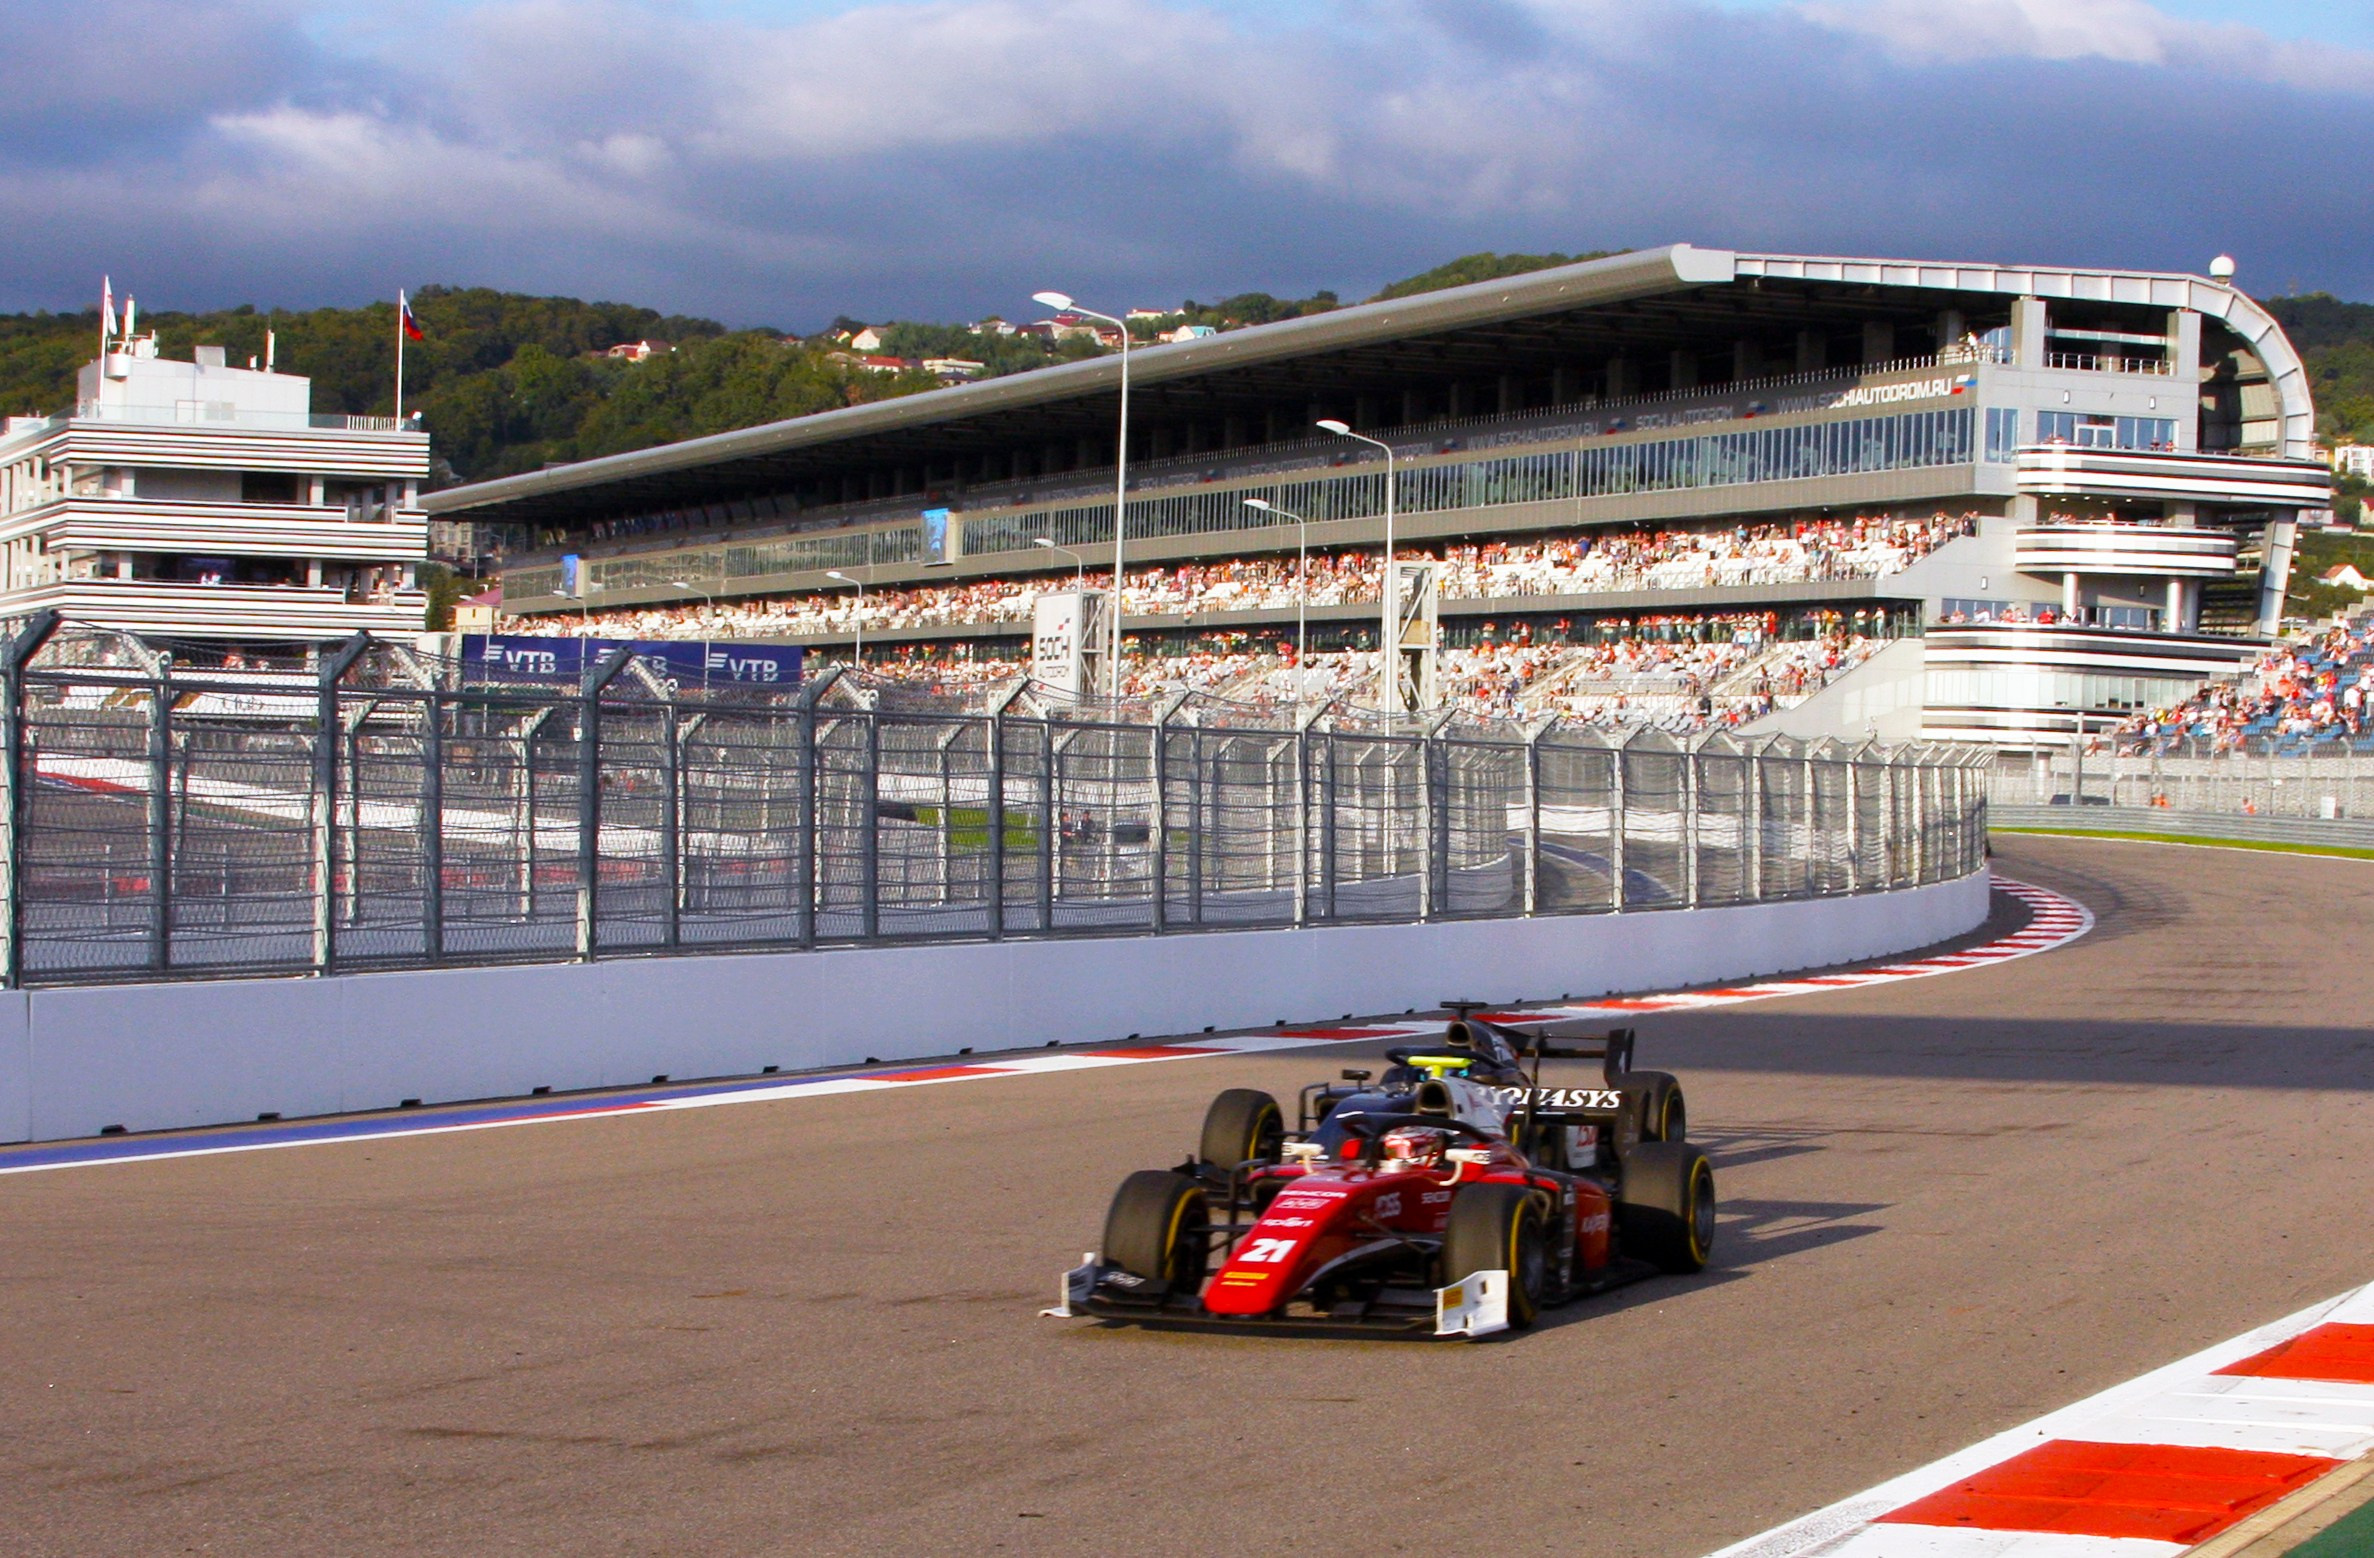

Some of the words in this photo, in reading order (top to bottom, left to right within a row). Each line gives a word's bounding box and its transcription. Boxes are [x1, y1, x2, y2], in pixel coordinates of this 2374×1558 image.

[1776, 378, 1952, 415] WWW.SOCHIAUTODROM.RU
[505, 649, 557, 675] VTB
[730, 658, 779, 683] VTB
[1238, 1238, 1299, 1263] 21
